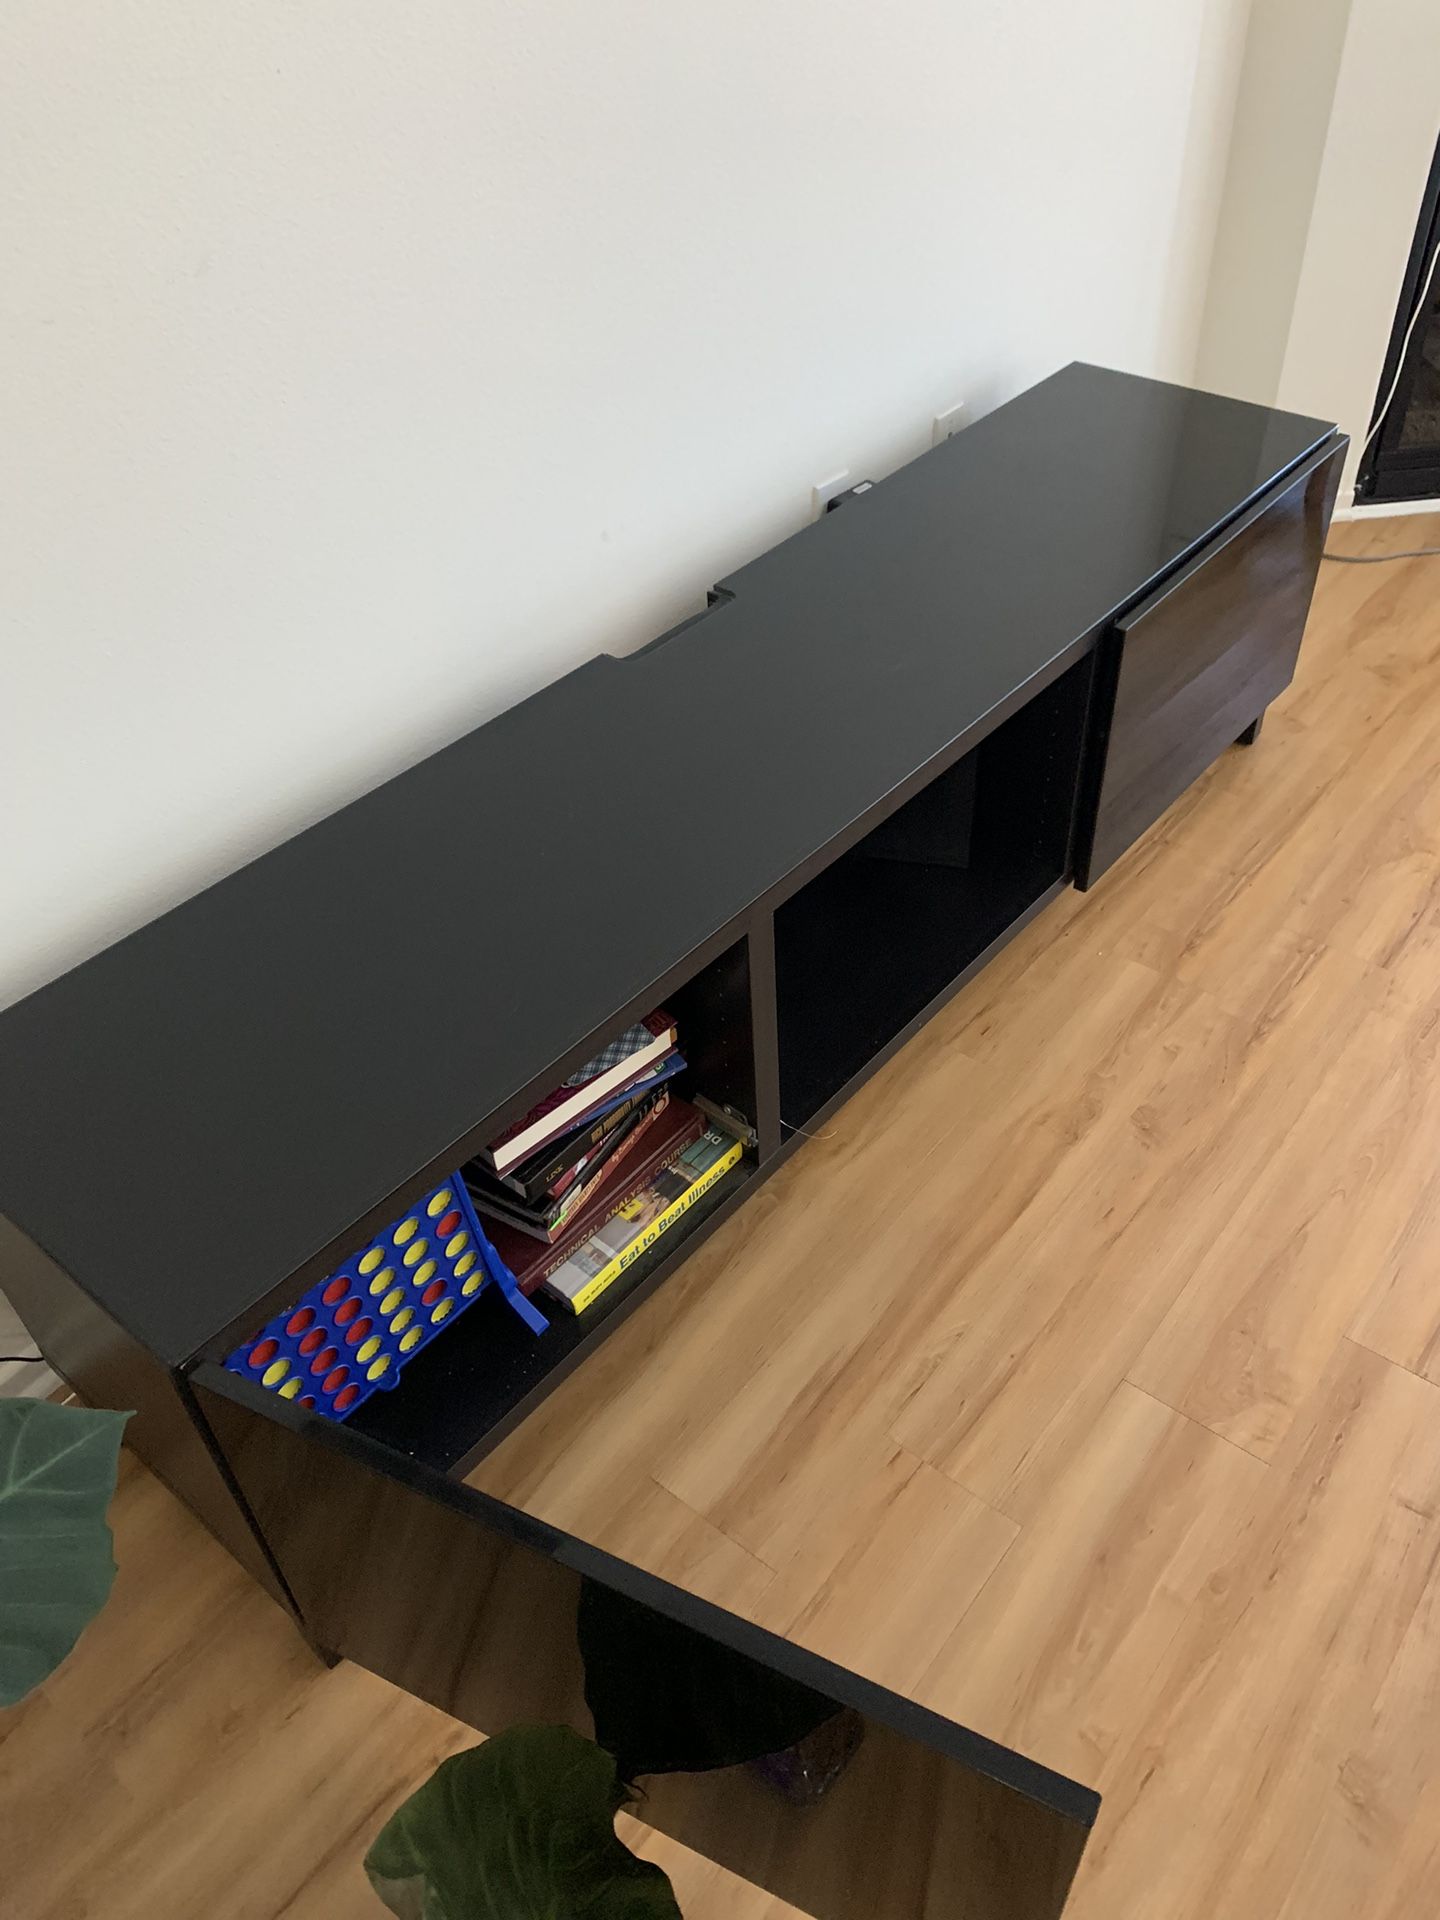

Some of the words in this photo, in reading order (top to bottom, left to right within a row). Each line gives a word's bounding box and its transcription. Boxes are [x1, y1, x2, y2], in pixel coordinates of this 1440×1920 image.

[543, 1225, 600, 1277] TECHNICAL
[604, 1175, 651, 1223] ANALYSIS
[655, 1138, 692, 1176] COURSE
[620, 1246, 640, 1269] Eat
[643, 1233, 656, 1247] to
[658, 1201, 686, 1232] Beat
[688, 1166, 725, 1204] Illness
